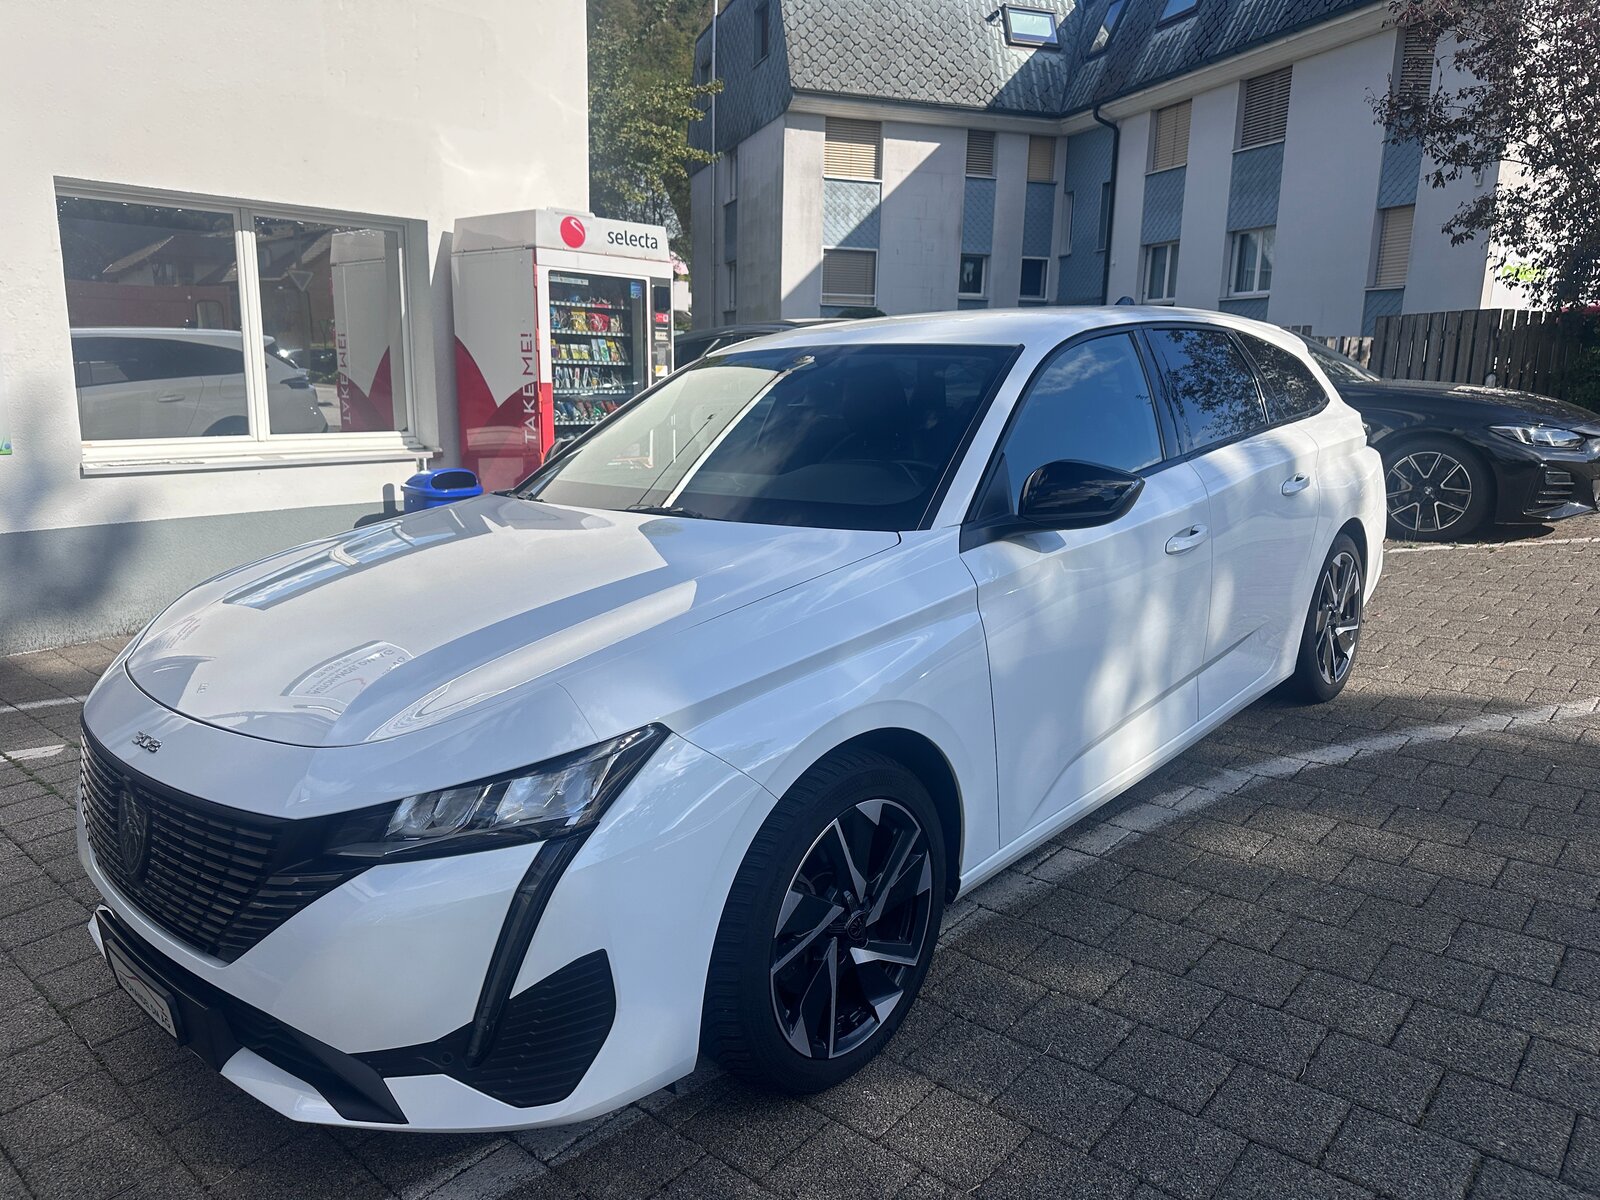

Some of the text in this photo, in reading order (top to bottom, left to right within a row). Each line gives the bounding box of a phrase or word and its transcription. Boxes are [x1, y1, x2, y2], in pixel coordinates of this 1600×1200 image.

[607, 230, 658, 250] selecta
[520, 333, 537, 444] TAKE ME!
[132, 731, 162, 754] 308
